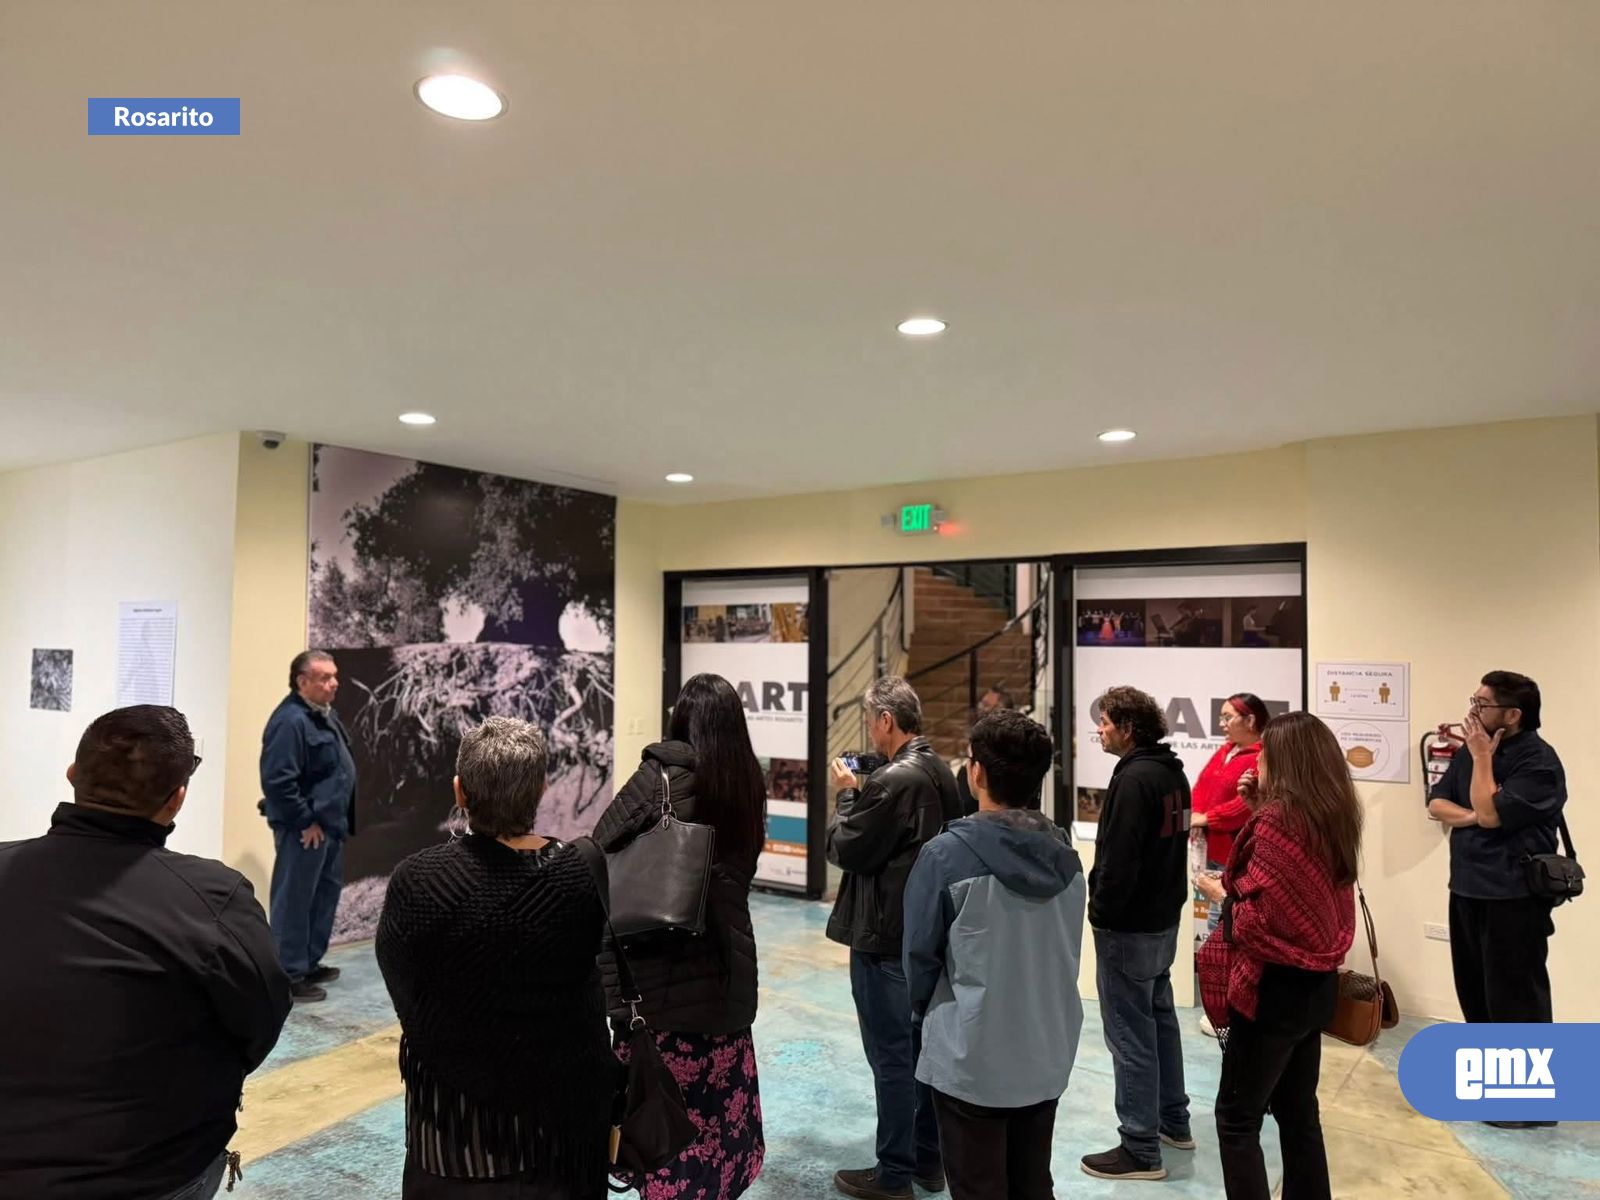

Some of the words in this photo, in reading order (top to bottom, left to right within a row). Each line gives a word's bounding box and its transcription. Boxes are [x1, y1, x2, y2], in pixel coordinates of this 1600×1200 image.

[902, 505, 931, 531] EXIT
[736, 681, 809, 712] ART
[1181, 741, 1198, 749] LAS
